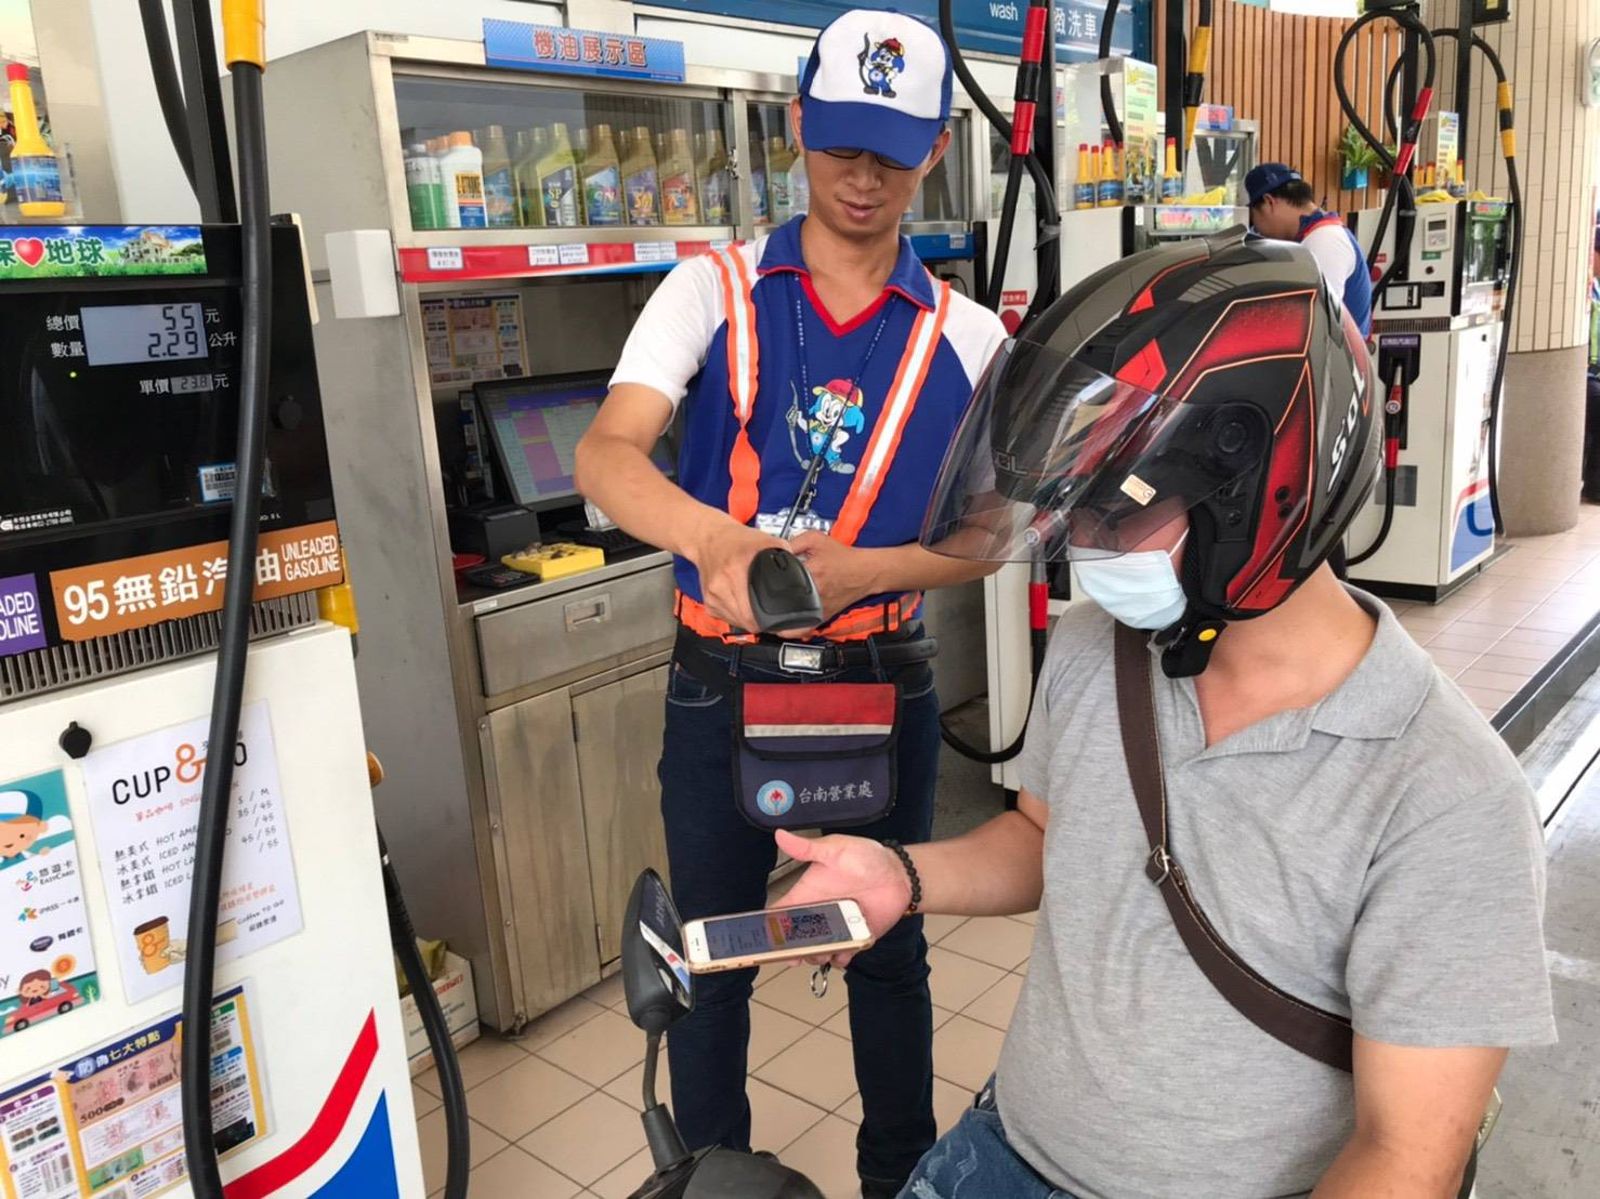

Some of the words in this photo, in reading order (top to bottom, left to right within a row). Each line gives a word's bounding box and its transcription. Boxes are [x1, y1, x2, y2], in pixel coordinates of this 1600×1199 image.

[989, 2, 1018, 21] wash
[532, 28, 649, 68] 機油展示區
[45, 238, 105, 265] 地球
[163, 305, 196, 331] 55
[205, 308, 220, 323] 元
[51, 341, 86, 357] 數量
[148, 331, 199, 358] 2.29
[208, 333, 237, 348] 公升
[139, 379, 171, 394] 單價
[213, 374, 230, 389] 元
[281, 534, 338, 562] UNLEADED
[284, 552, 341, 581] GASOLINE
[111, 764, 171, 805] CUP
[798, 778, 875, 804] 台南營業處
